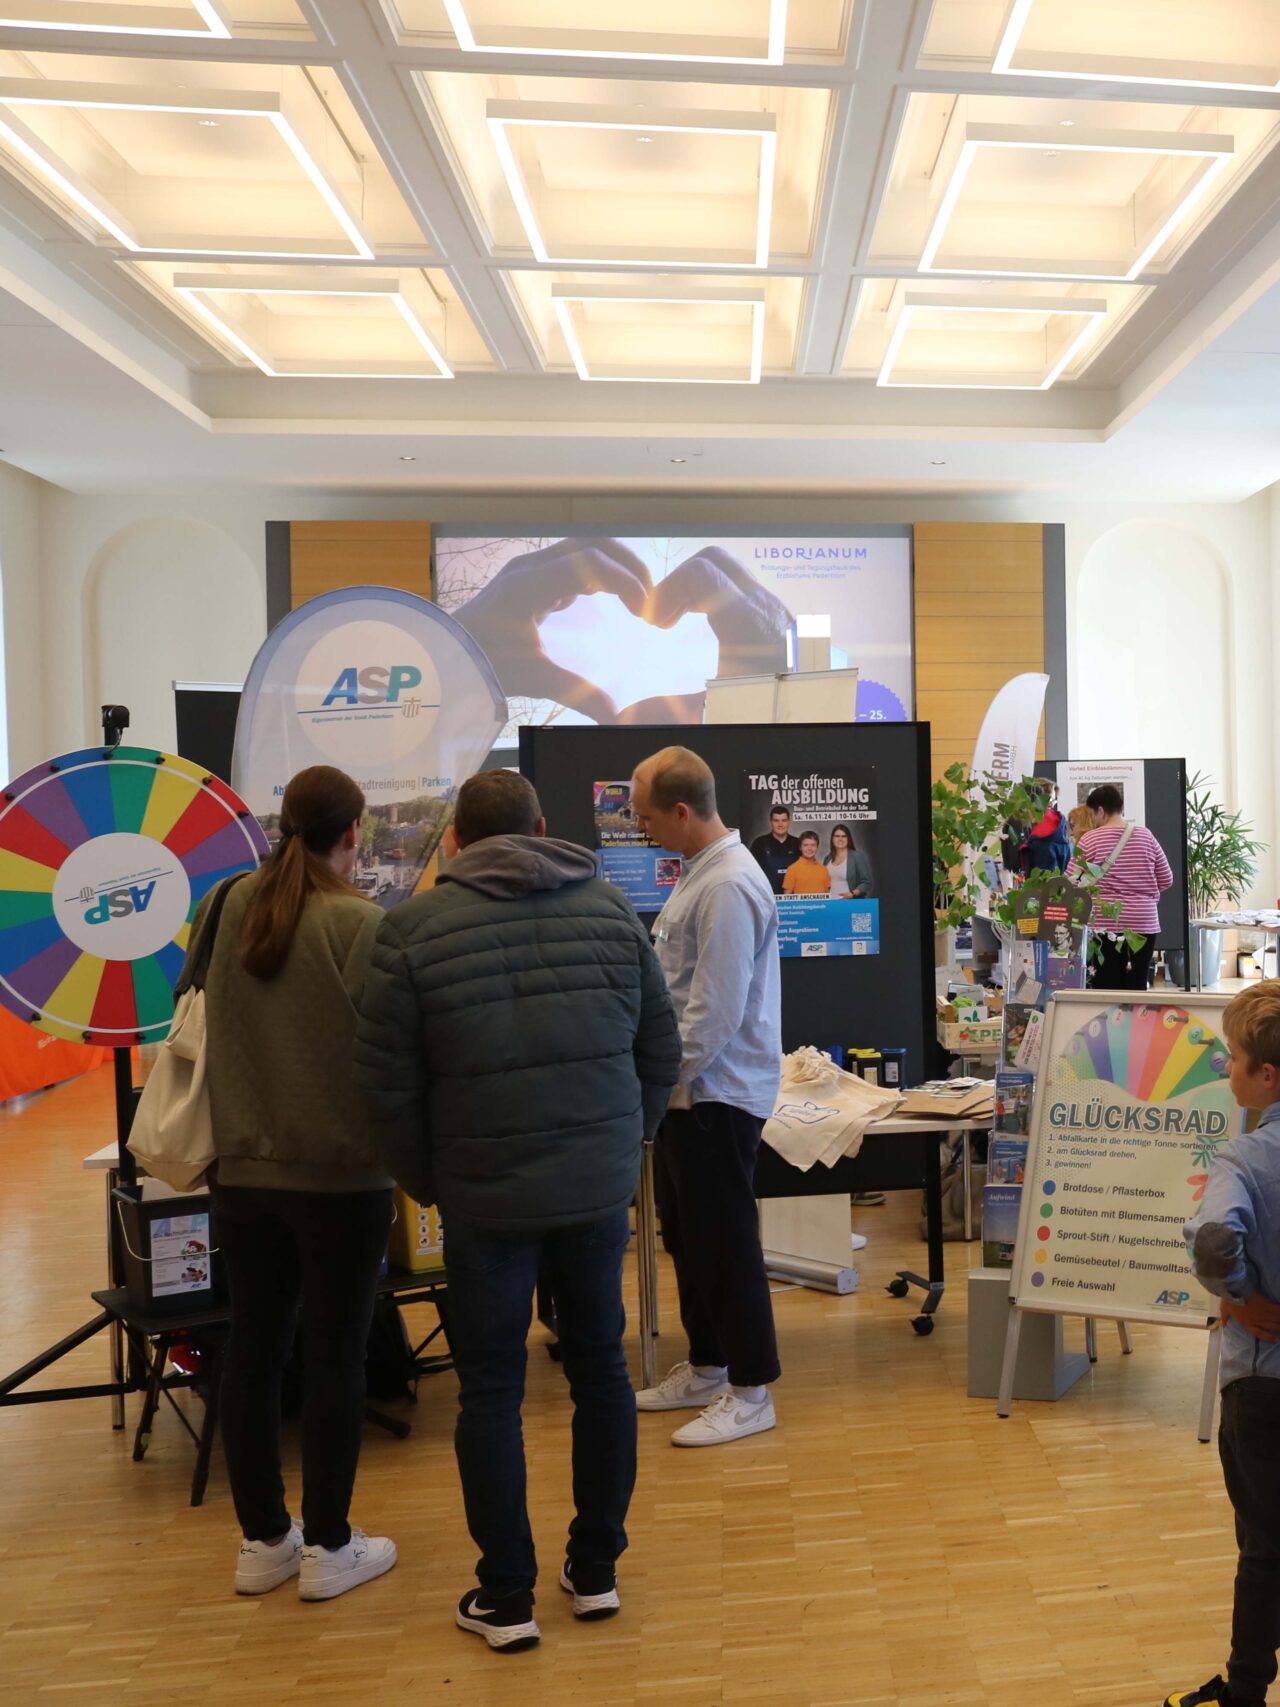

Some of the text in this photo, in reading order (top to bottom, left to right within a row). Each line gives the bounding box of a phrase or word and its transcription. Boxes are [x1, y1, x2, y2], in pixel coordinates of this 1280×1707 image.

[754, 547, 867, 560] LIBORIANUM
[321, 665, 422, 707] ASP
[870, 710, 887, 720] 25.
[357, 776, 416, 791] tadtreinigung
[422, 776, 452, 788] Parken
[748, 774, 844, 790] TAG der offenen
[771, 788, 869, 804] AUSBILDUNG
[84, 880, 157, 925] ASP
[1050, 1098, 1229, 1137] GLÜCKSRAD
[1048, 1134, 1218, 1152] 1. Abfallkarte in die richtige Tonne sortieren,
[1047, 1146, 1054, 1154] 2.
[1070, 1147, 1107, 1158] Glücksrad
[1109, 1150, 1137, 1160] drehen,
[1054, 1160, 1092, 1169] gewinnen!
[1062, 1182, 1104, 1194] Brotdose
[1112, 1186, 1166, 1198] Pflasterbox
[1060, 1206, 1186, 1224] Biotüten mit Blumensamen
[1056, 1230, 1110, 1243] Sprout-Stift
[1118, 1234, 1186, 1249] Kugelschreibe
[1054, 1253, 1120, 1268] Gemüsebeutel
[1052, 1277, 1116, 1292] Freie Auswahl
[1155, 1290, 1190, 1306] ASP
